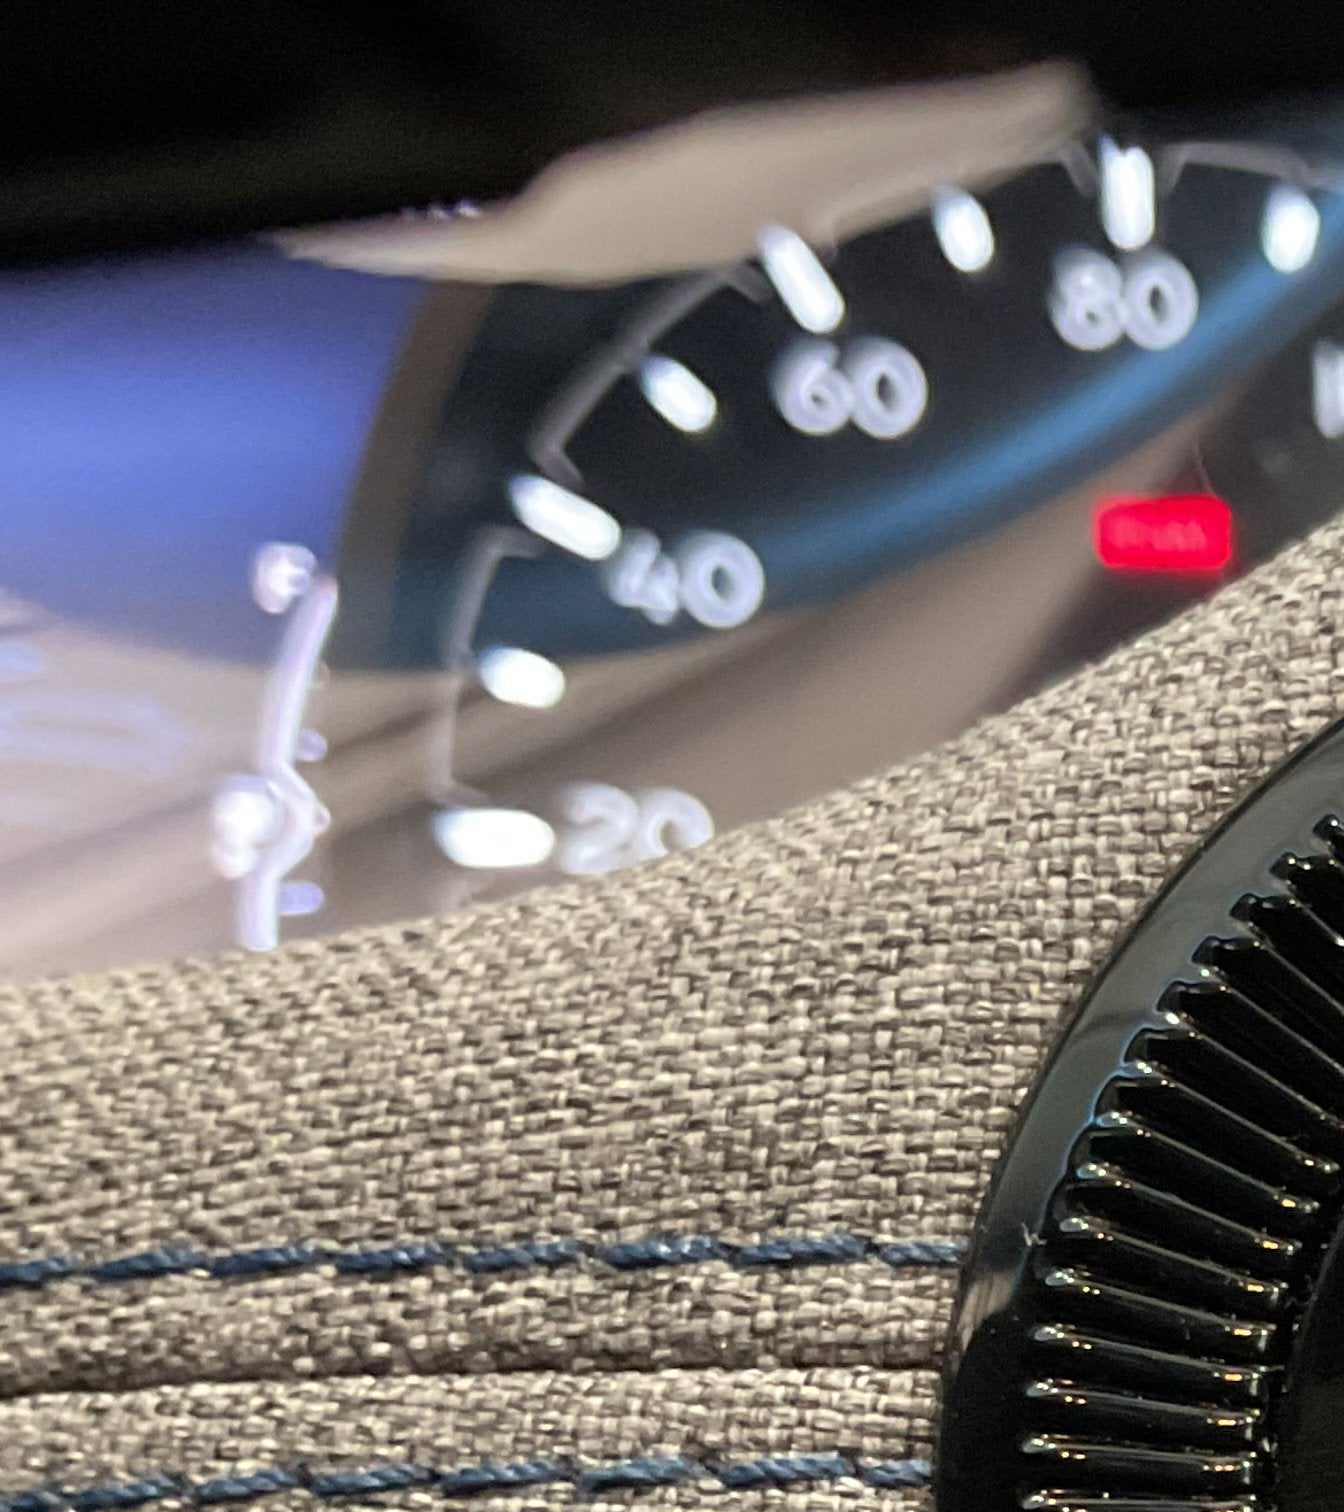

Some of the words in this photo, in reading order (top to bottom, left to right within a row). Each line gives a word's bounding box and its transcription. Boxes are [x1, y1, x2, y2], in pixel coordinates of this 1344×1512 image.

[1050, 247, 1197, 350] 80
[773, 338, 928, 438] 60
[607, 529, 765, 628] 40
[557, 782, 714, 876] 20
